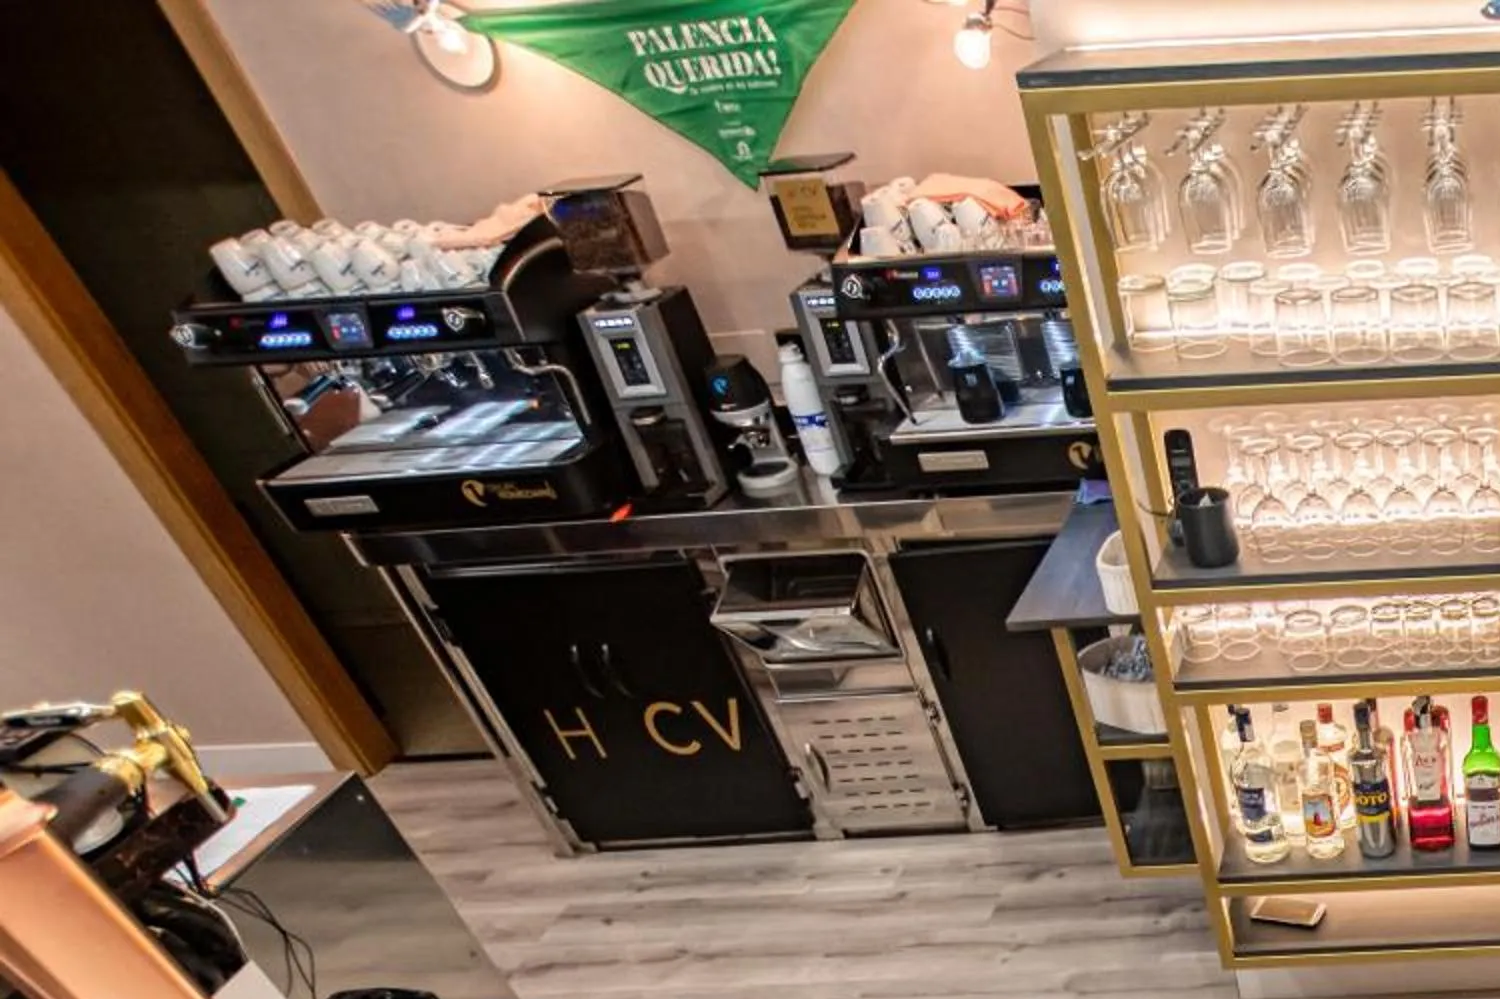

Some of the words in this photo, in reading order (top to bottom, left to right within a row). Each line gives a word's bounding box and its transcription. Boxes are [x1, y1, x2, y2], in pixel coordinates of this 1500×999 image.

[627, 16, 777, 56] PALENCIA
[643, 49, 782, 95] QUERIDA!
[544, 707, 608, 760] H
[644, 698, 742, 756] CV
